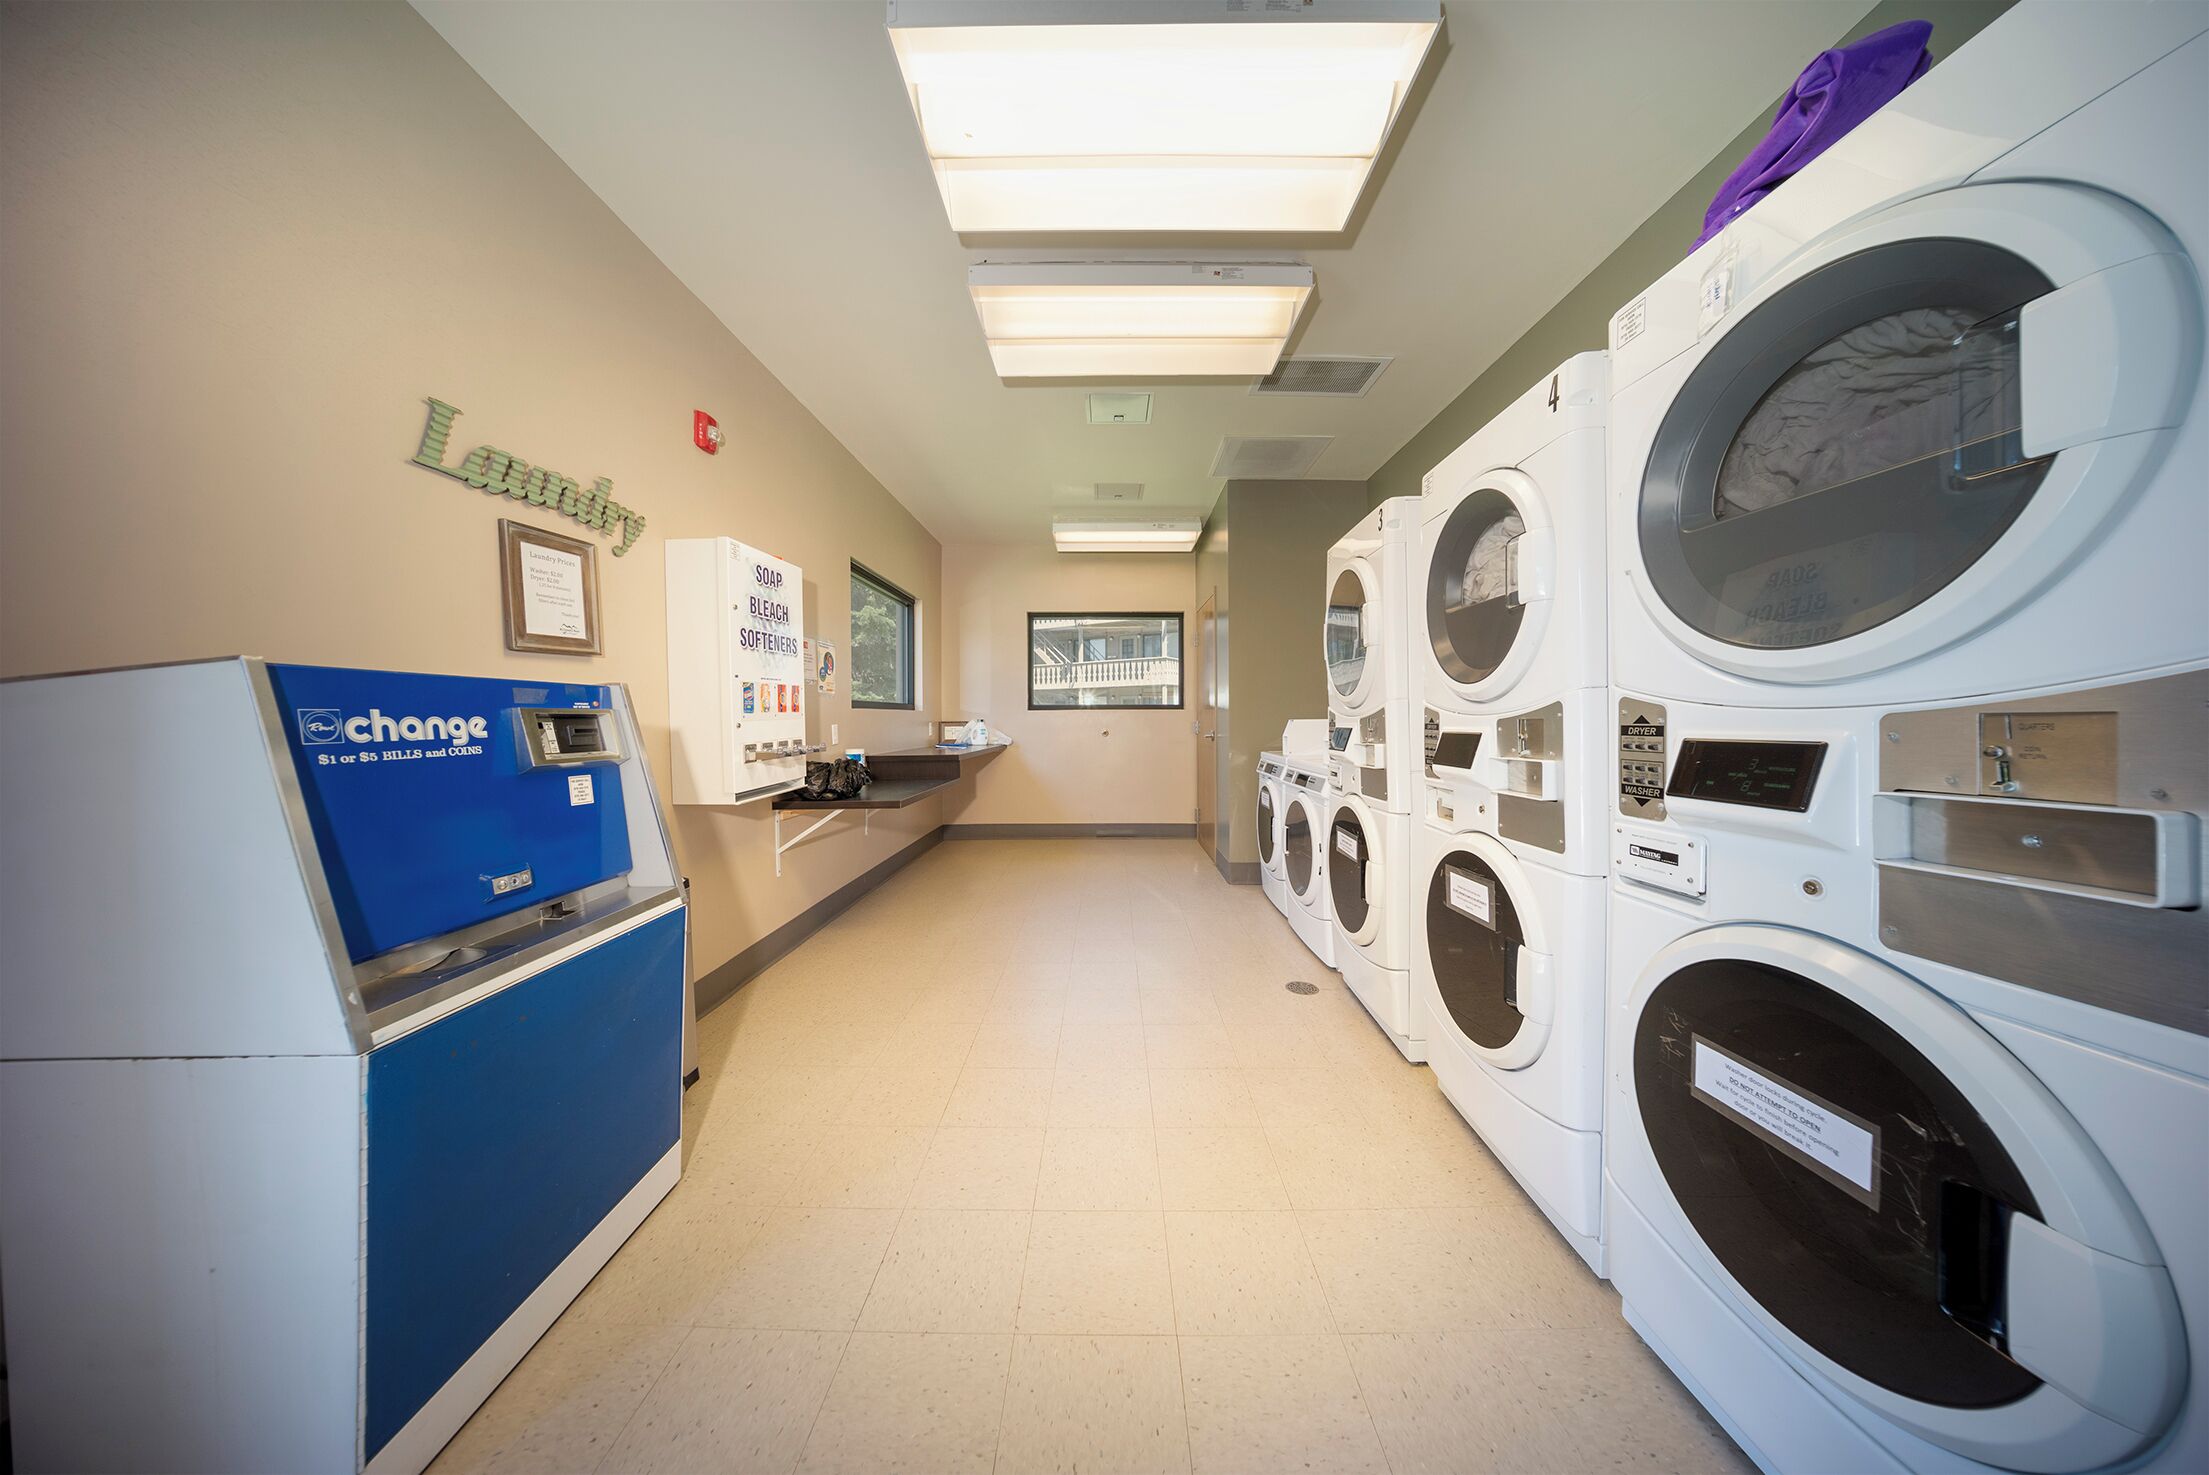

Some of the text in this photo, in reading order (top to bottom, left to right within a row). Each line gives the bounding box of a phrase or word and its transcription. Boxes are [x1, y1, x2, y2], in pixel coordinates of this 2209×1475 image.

[1548, 374, 1560, 413] 4
[411, 397, 646, 557] Laundry
[1377, 508, 1384, 532] 3
[529, 551, 557, 564] Laundry
[755, 564, 783, 589] SOAP
[749, 595, 790, 623] BLEACH
[739, 627, 799, 655] SOFTENERS
[344, 708, 489, 747] change
[1627, 726, 1657, 737] DRYER
[318, 745, 483, 765] $1 or $5 BILLS and COINS
[1624, 785, 1661, 798] WASHER
[1725, 1063, 1748, 1078] Washer
[1748, 1077, 1763, 1087] door
[1765, 1085, 1781, 1097] locks
[1782, 1095, 1805, 1112] during
[1729, 1076, 1740, 1086] DO
[1740, 1083, 1754, 1094] NOT
[1755, 1091, 1787, 1113] ATTEMPT
[1787, 1109, 1799, 1119] TO
[1783, 1118, 1807, 1136] before
[1808, 1134, 1840, 1157] opening
